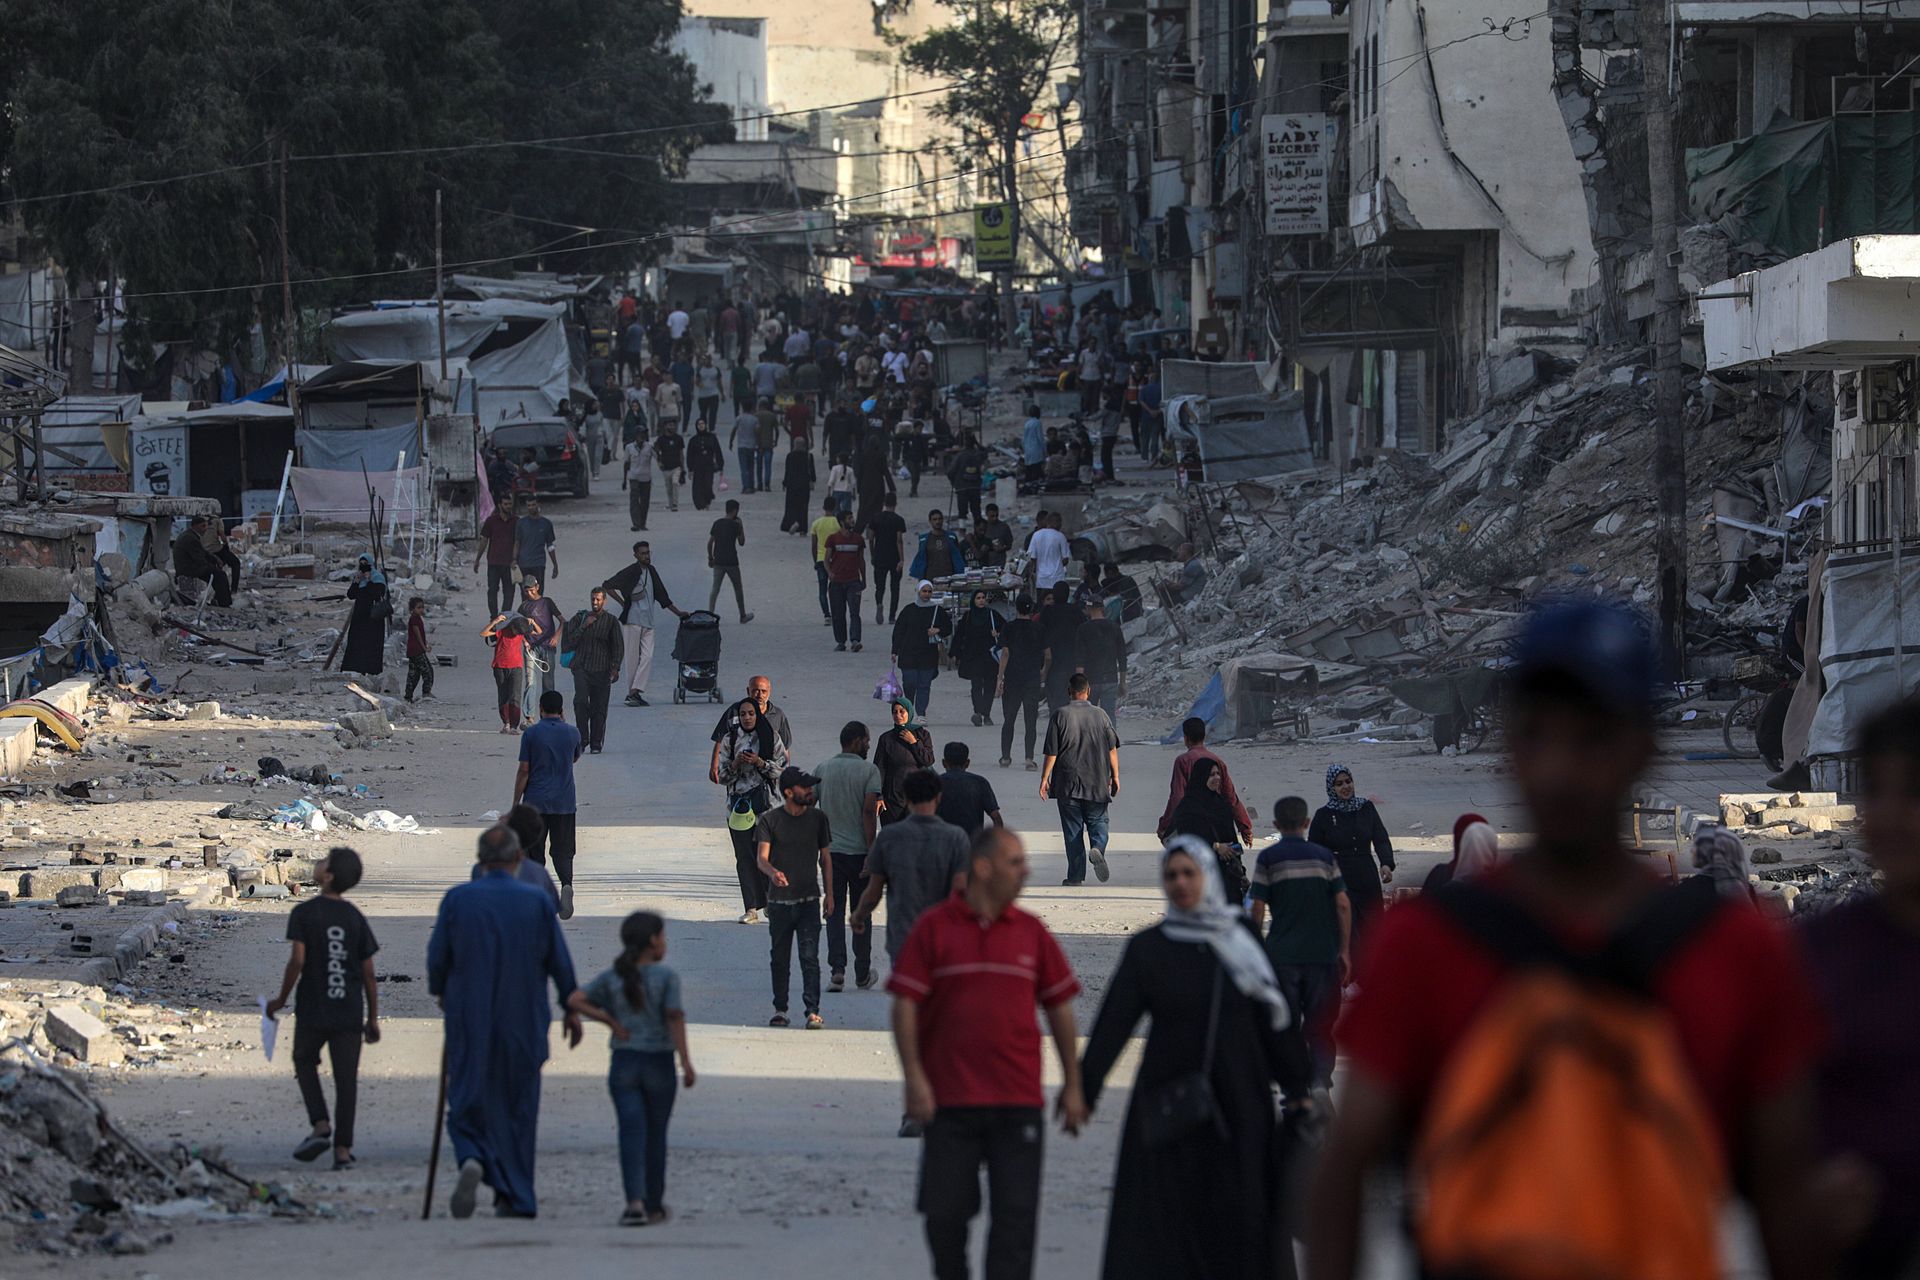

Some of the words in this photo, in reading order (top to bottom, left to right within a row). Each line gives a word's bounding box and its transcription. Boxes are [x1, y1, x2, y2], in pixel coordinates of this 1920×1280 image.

[1268, 131, 1319, 143] LADY
[1268, 144, 1320, 154] SECRET
[1267, 164, 1302, 181] المرأة
[1304, 168, 1323, 180] سر
[327, 926, 348, 998] adidas
